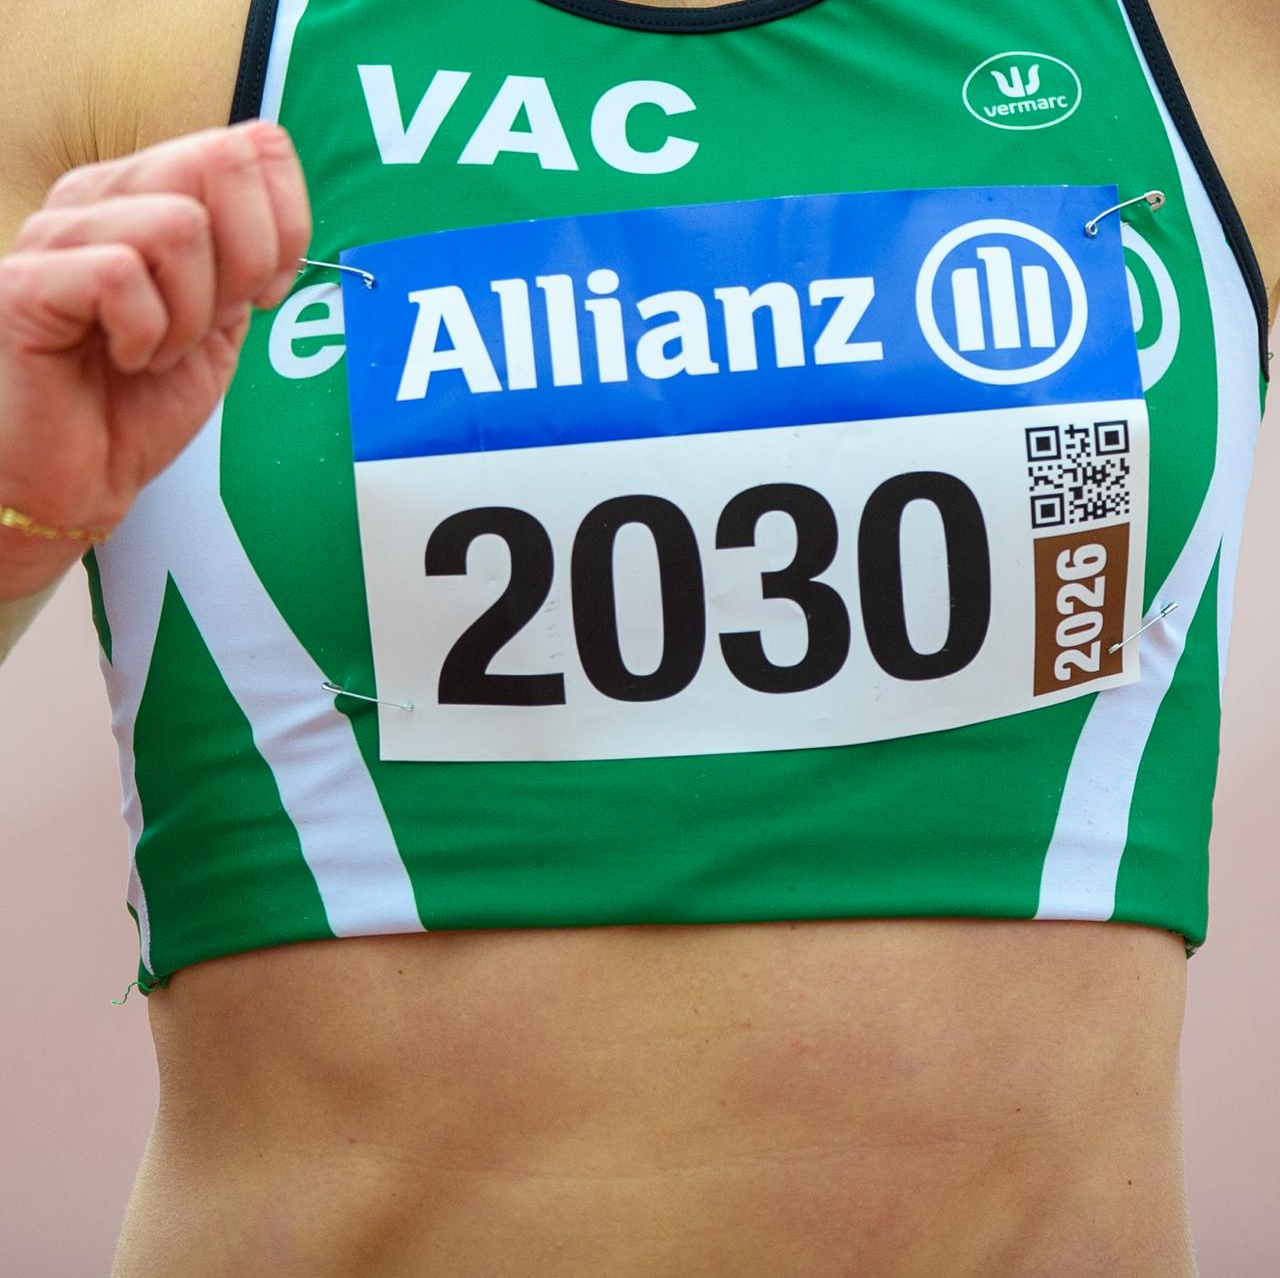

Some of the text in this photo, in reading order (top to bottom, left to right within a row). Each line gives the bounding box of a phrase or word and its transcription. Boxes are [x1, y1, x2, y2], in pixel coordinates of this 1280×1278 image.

[357, 64, 699, 175] VAC
[983, 95, 1069, 118] vermarc
[396, 269, 884, 402] Allianz
[424, 470, 992, 706] 2030
[1054, 543, 1108, 682] 2026
